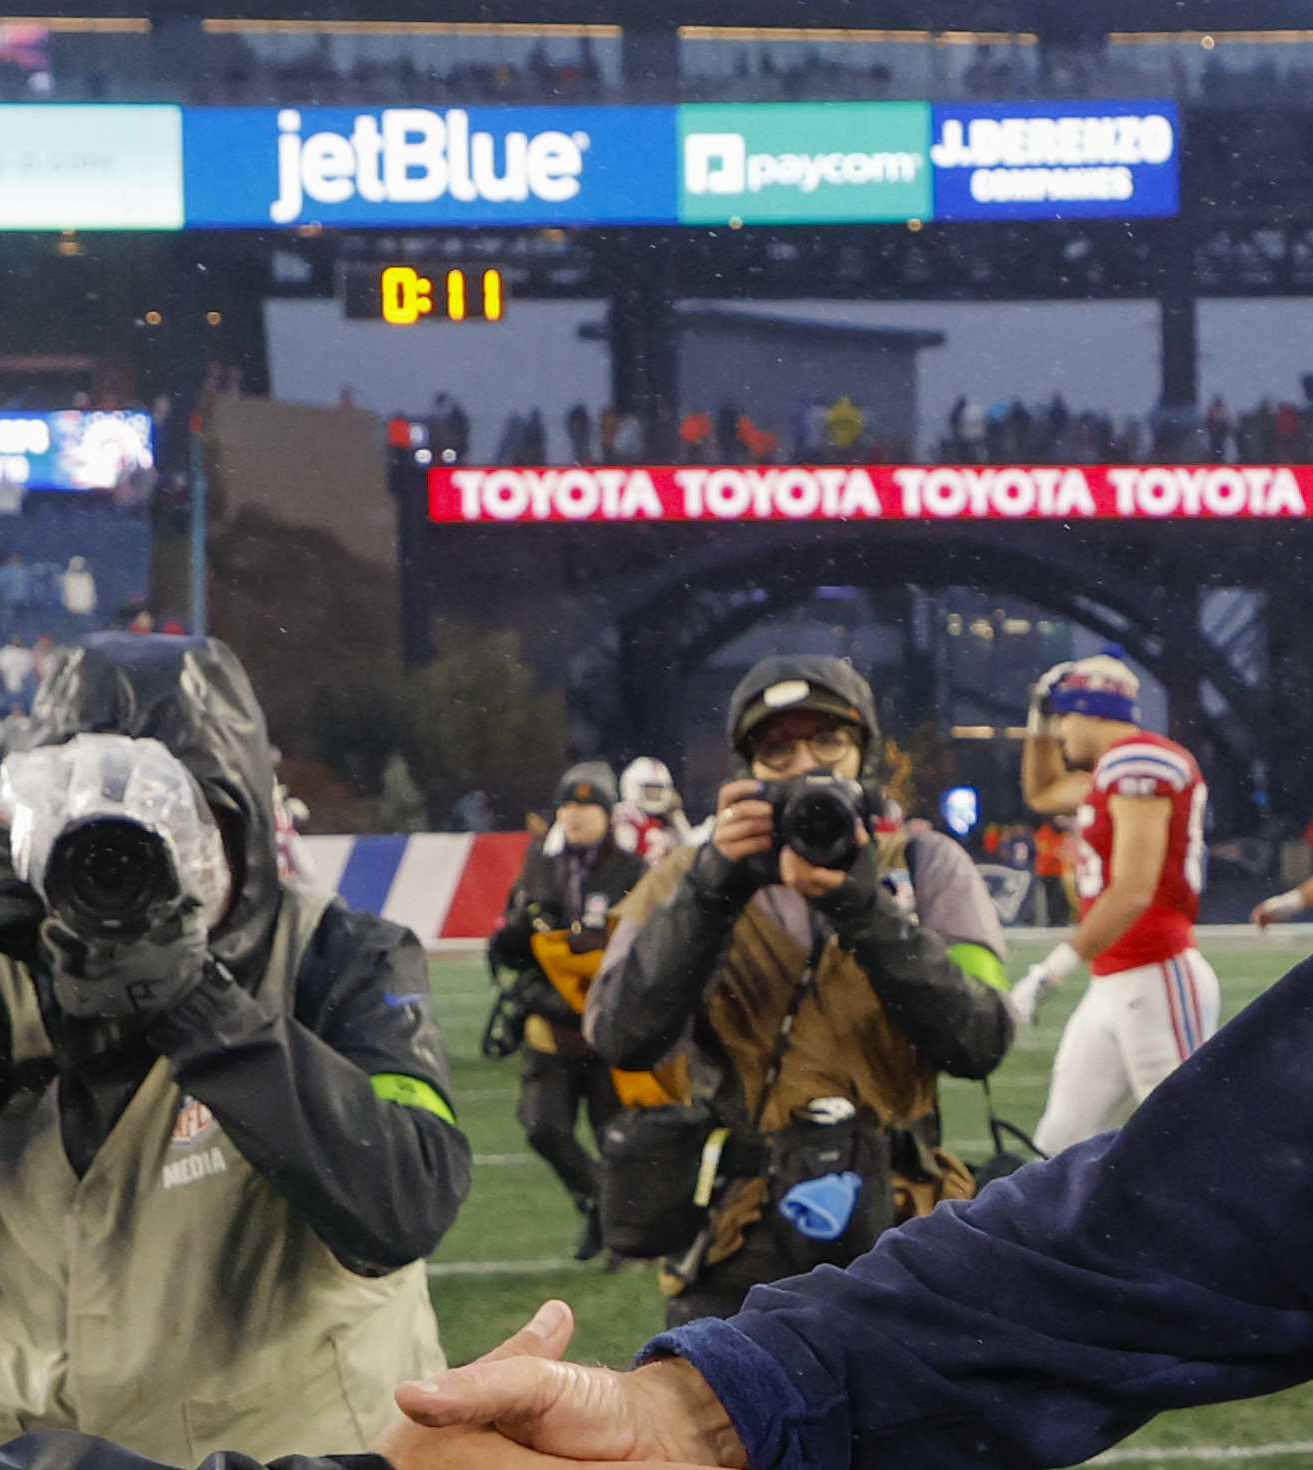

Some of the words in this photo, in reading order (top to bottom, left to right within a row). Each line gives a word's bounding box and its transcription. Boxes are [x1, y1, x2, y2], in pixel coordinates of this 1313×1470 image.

[270, 108, 583, 224] jetBlue
[747, 152, 917, 193] paycom
[381, 266, 503, 325] 0:11
[451, 469, 663, 520] TOYOTA
[675, 468, 883, 519] TOYOTA
[893, 467, 1097, 518] TOYOTA
[1106, 467, 1307, 518] TOYOTA
[162, 1146, 228, 1190] MEDIA
